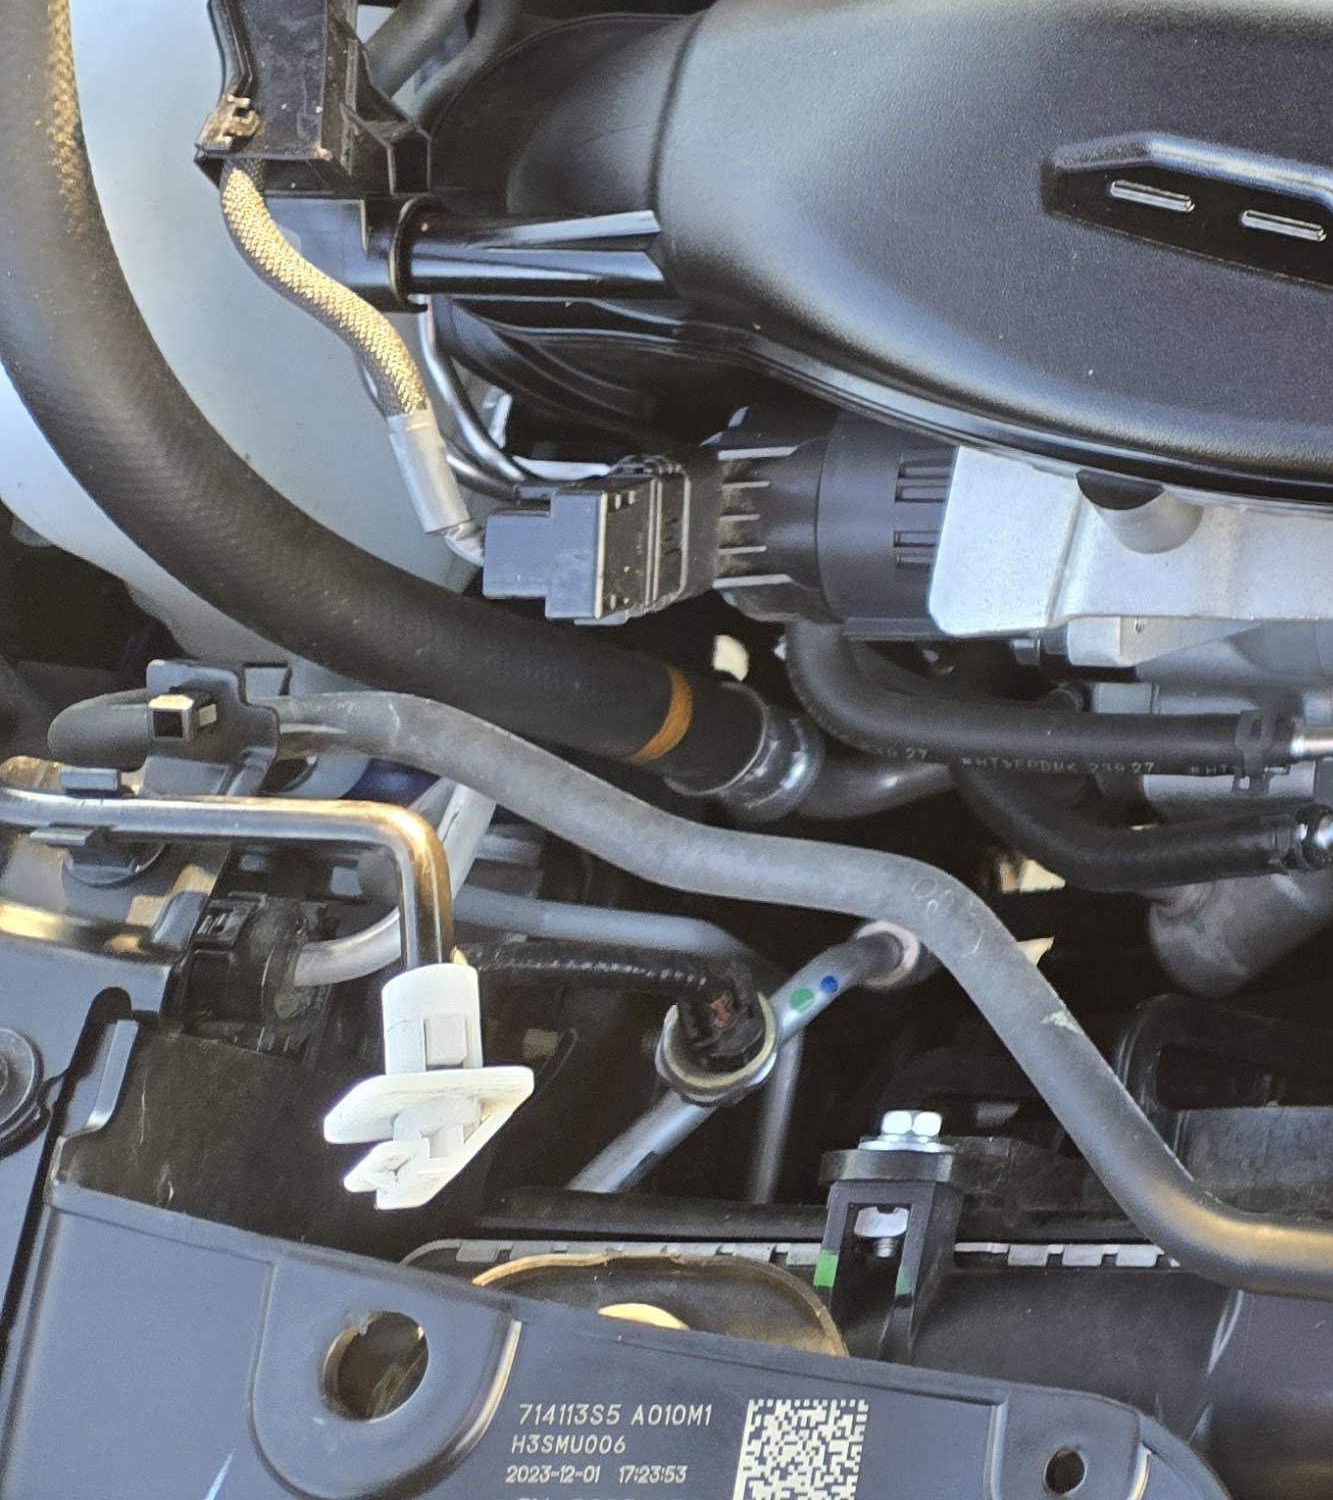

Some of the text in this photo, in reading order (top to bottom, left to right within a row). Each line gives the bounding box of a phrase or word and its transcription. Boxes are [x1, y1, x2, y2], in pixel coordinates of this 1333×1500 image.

[518, 1404, 713, 1427] 714113S5 A010M1
[511, 1434, 626, 1455] H3SMU006
[505, 1464, 688, 1484] 2023-12-01 17:23:53
